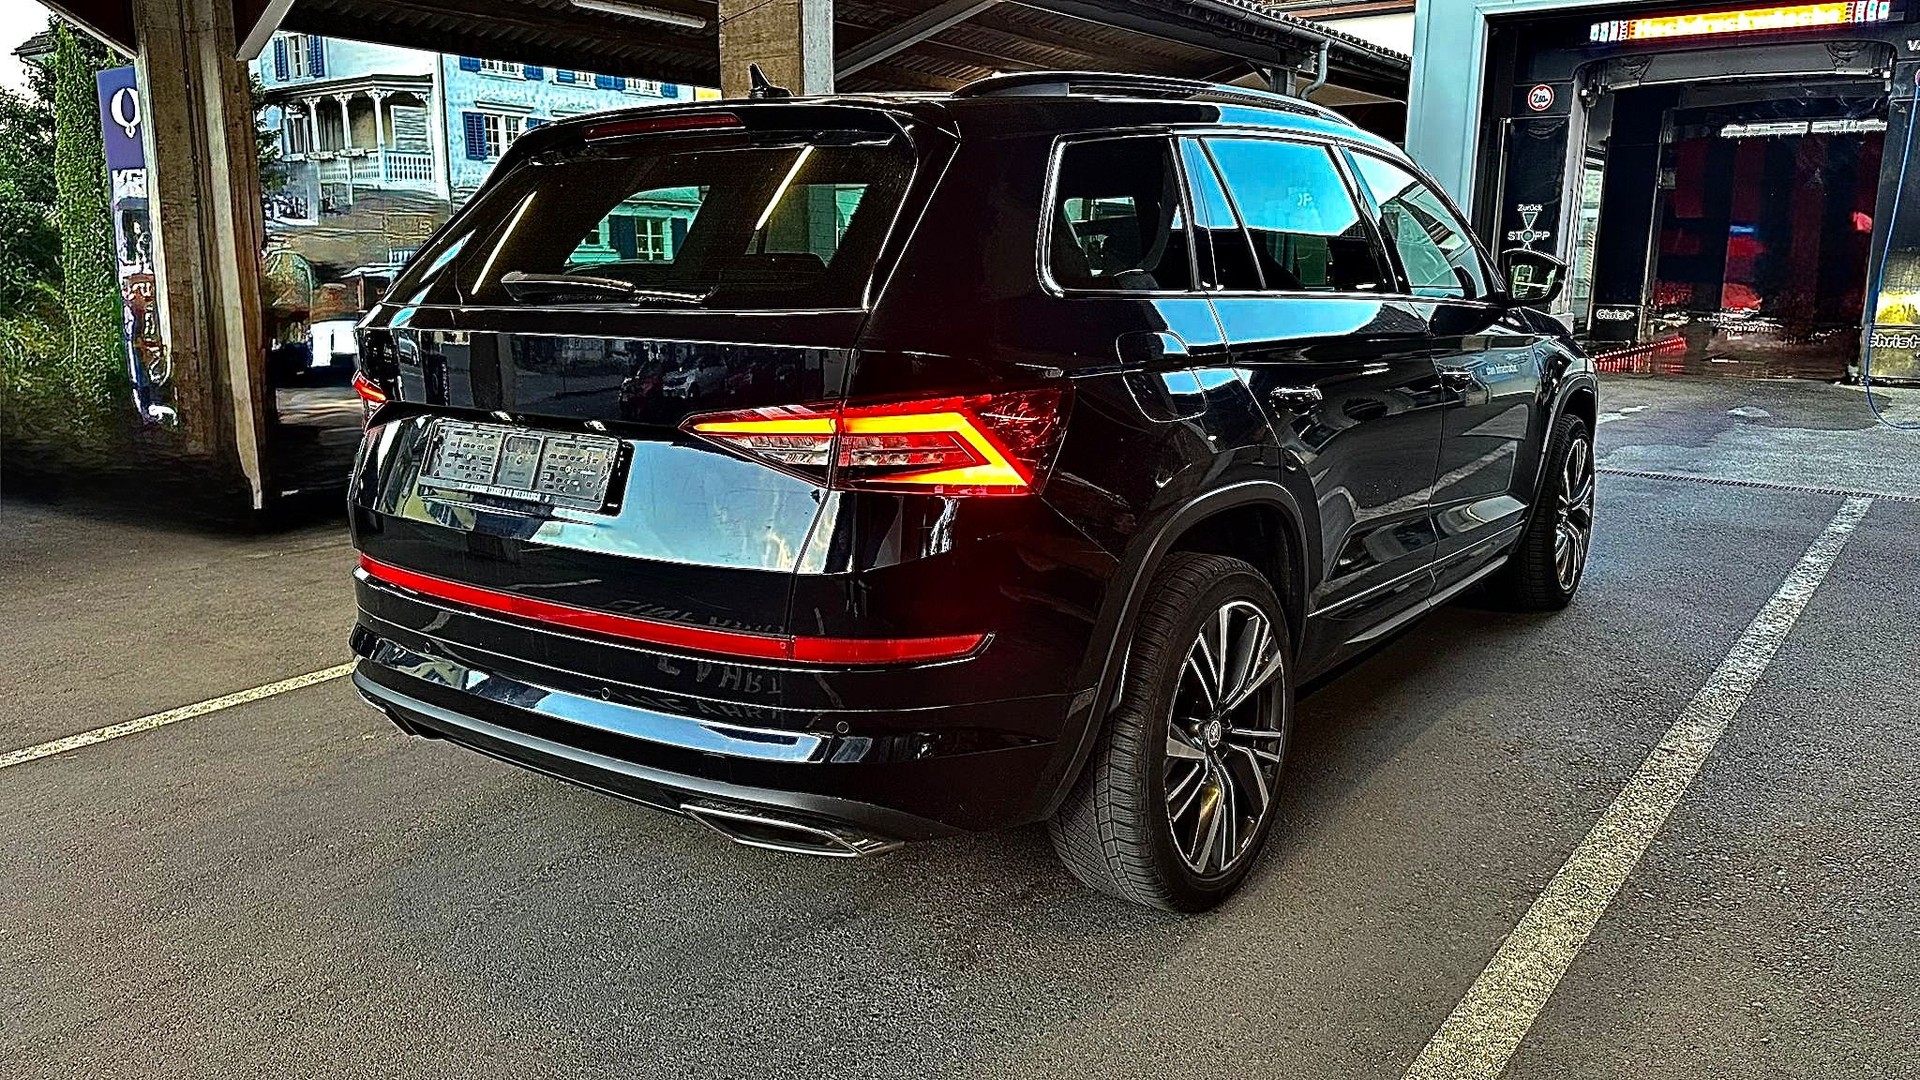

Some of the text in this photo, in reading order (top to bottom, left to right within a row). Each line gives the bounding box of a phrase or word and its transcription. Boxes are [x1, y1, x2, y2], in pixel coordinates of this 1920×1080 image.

[1907, 39, 1920, 51] V
[1517, 203, 1543, 212] Zurück
[1596, 308, 1635, 320] Christ
